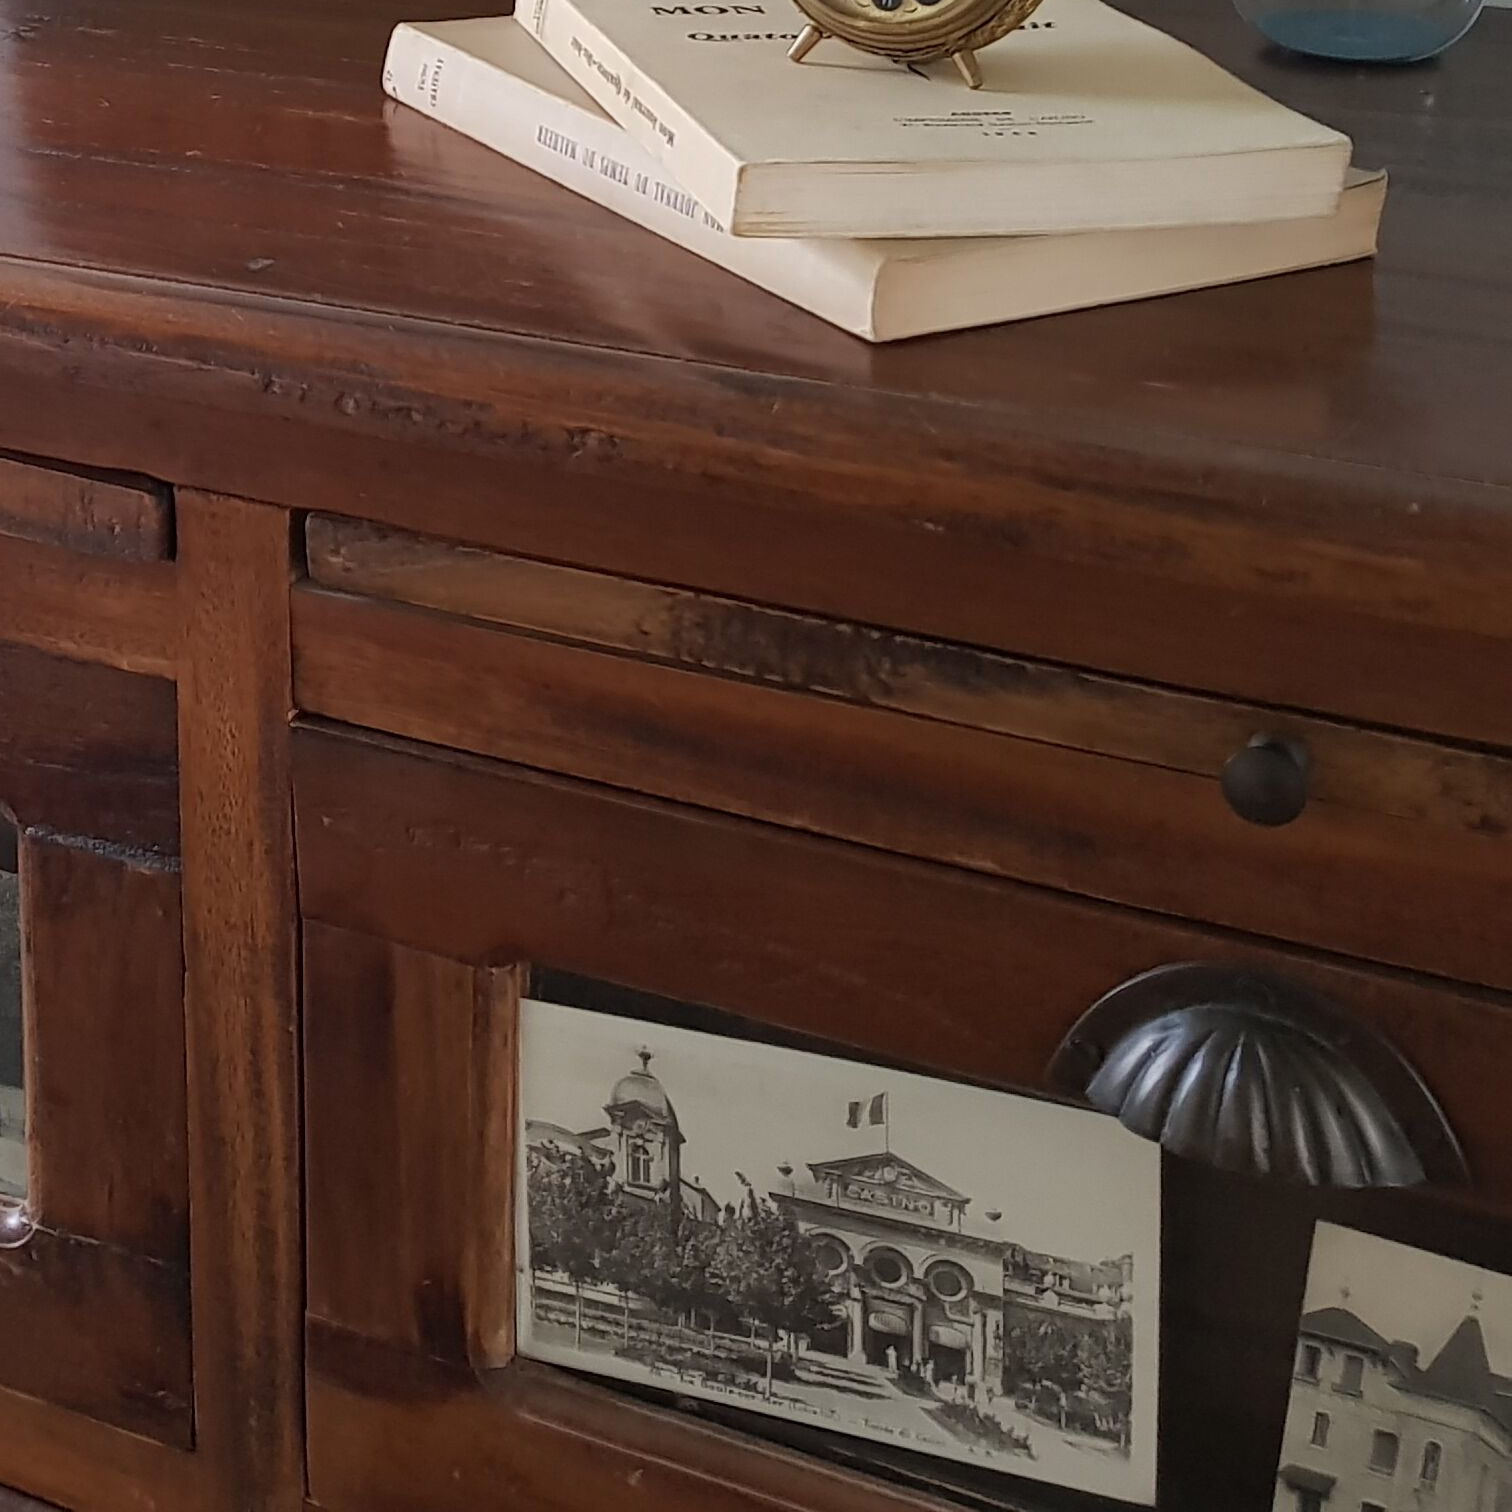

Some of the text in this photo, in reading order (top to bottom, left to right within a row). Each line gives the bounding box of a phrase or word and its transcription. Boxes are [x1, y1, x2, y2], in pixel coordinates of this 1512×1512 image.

[650, 4, 767, 17] MON
[600, 156, 630, 186] TEMPS
[635, 173, 649, 196] DU
[654, 182, 698, 219] JOURNAL
[846, 1184, 932, 1214] CASINO
